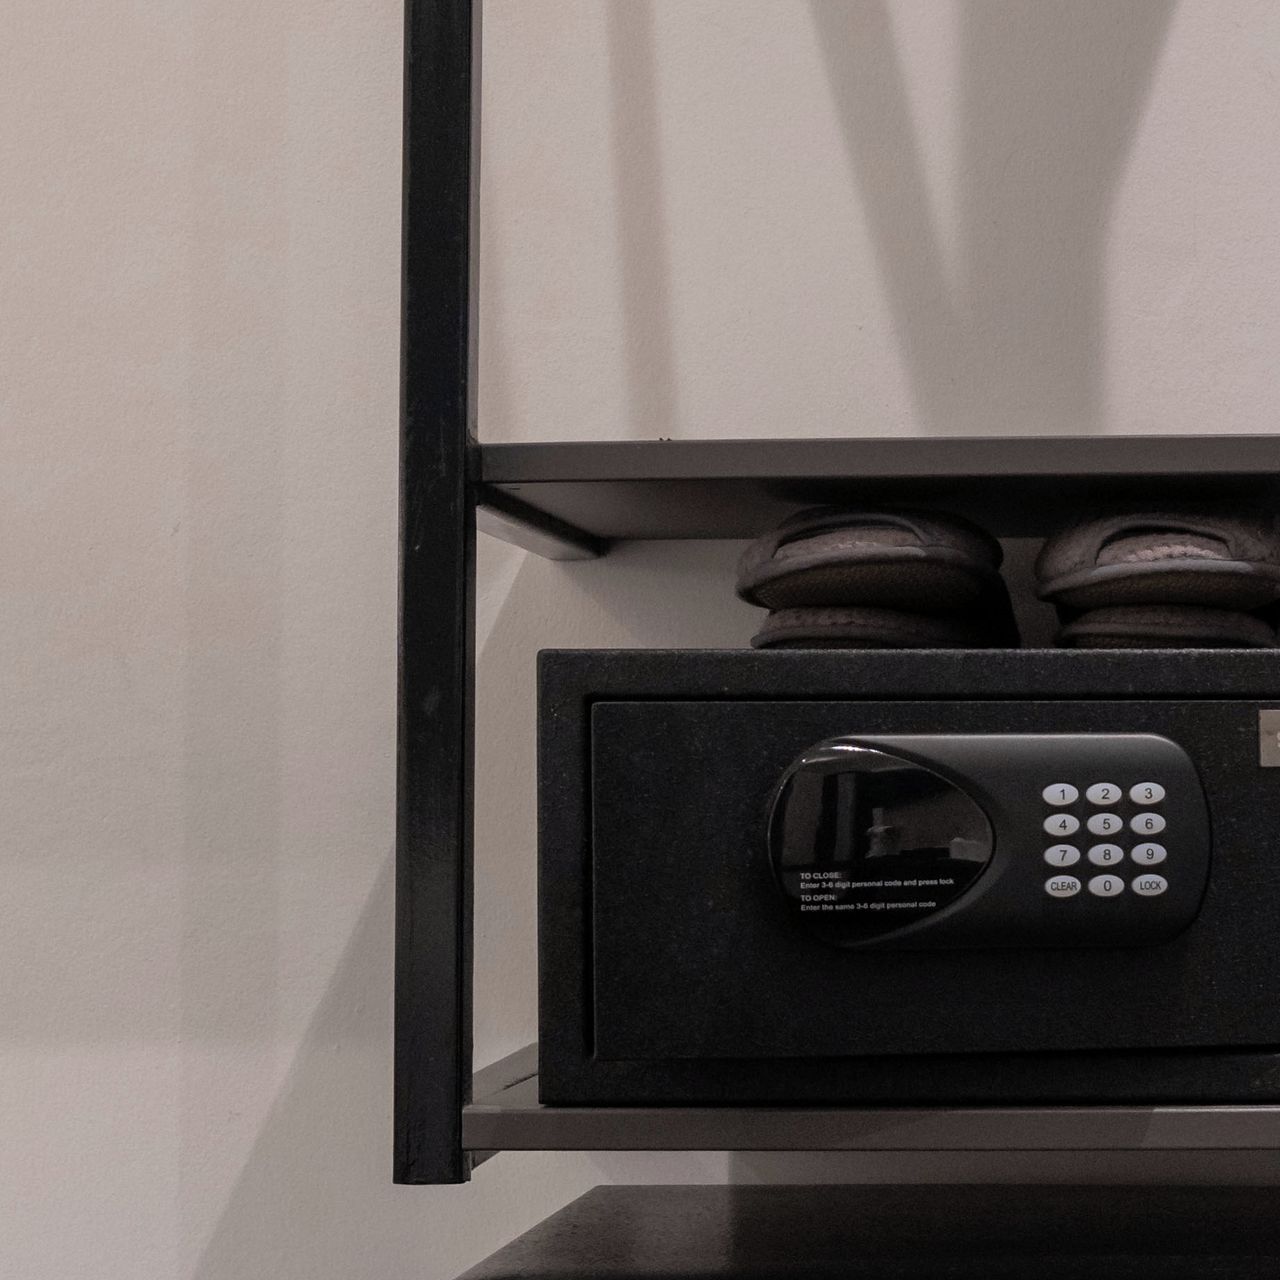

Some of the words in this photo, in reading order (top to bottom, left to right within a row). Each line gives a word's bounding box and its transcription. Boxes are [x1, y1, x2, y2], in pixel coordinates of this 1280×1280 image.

[1060, 789, 1066, 800] 1
[1101, 788, 1110, 800] 2
[1144, 787, 1153, 800] 3
[1059, 819, 1068, 830] 4
[1102, 818, 1111, 830] 5
[1145, 818, 1153, 830] 6
[1059, 849, 1068, 861] 7
[1103, 848, 1112, 861] 8
[1146, 848, 1155, 860] 9
[800, 872, 812, 880] TO
[800, 881, 820, 889] Enter
[834, 880, 851, 890] digit
[851, 880, 883, 889] personal
[918, 879, 938, 887] press
[1050, 881, 1078, 891] CLEAR
[1140, 880, 1162, 890] LOCK
[800, 894, 812, 902] TO
[869, 901, 886, 911] digit
[886, 901, 918, 910] personal
[918, 900, 937, 908] code
